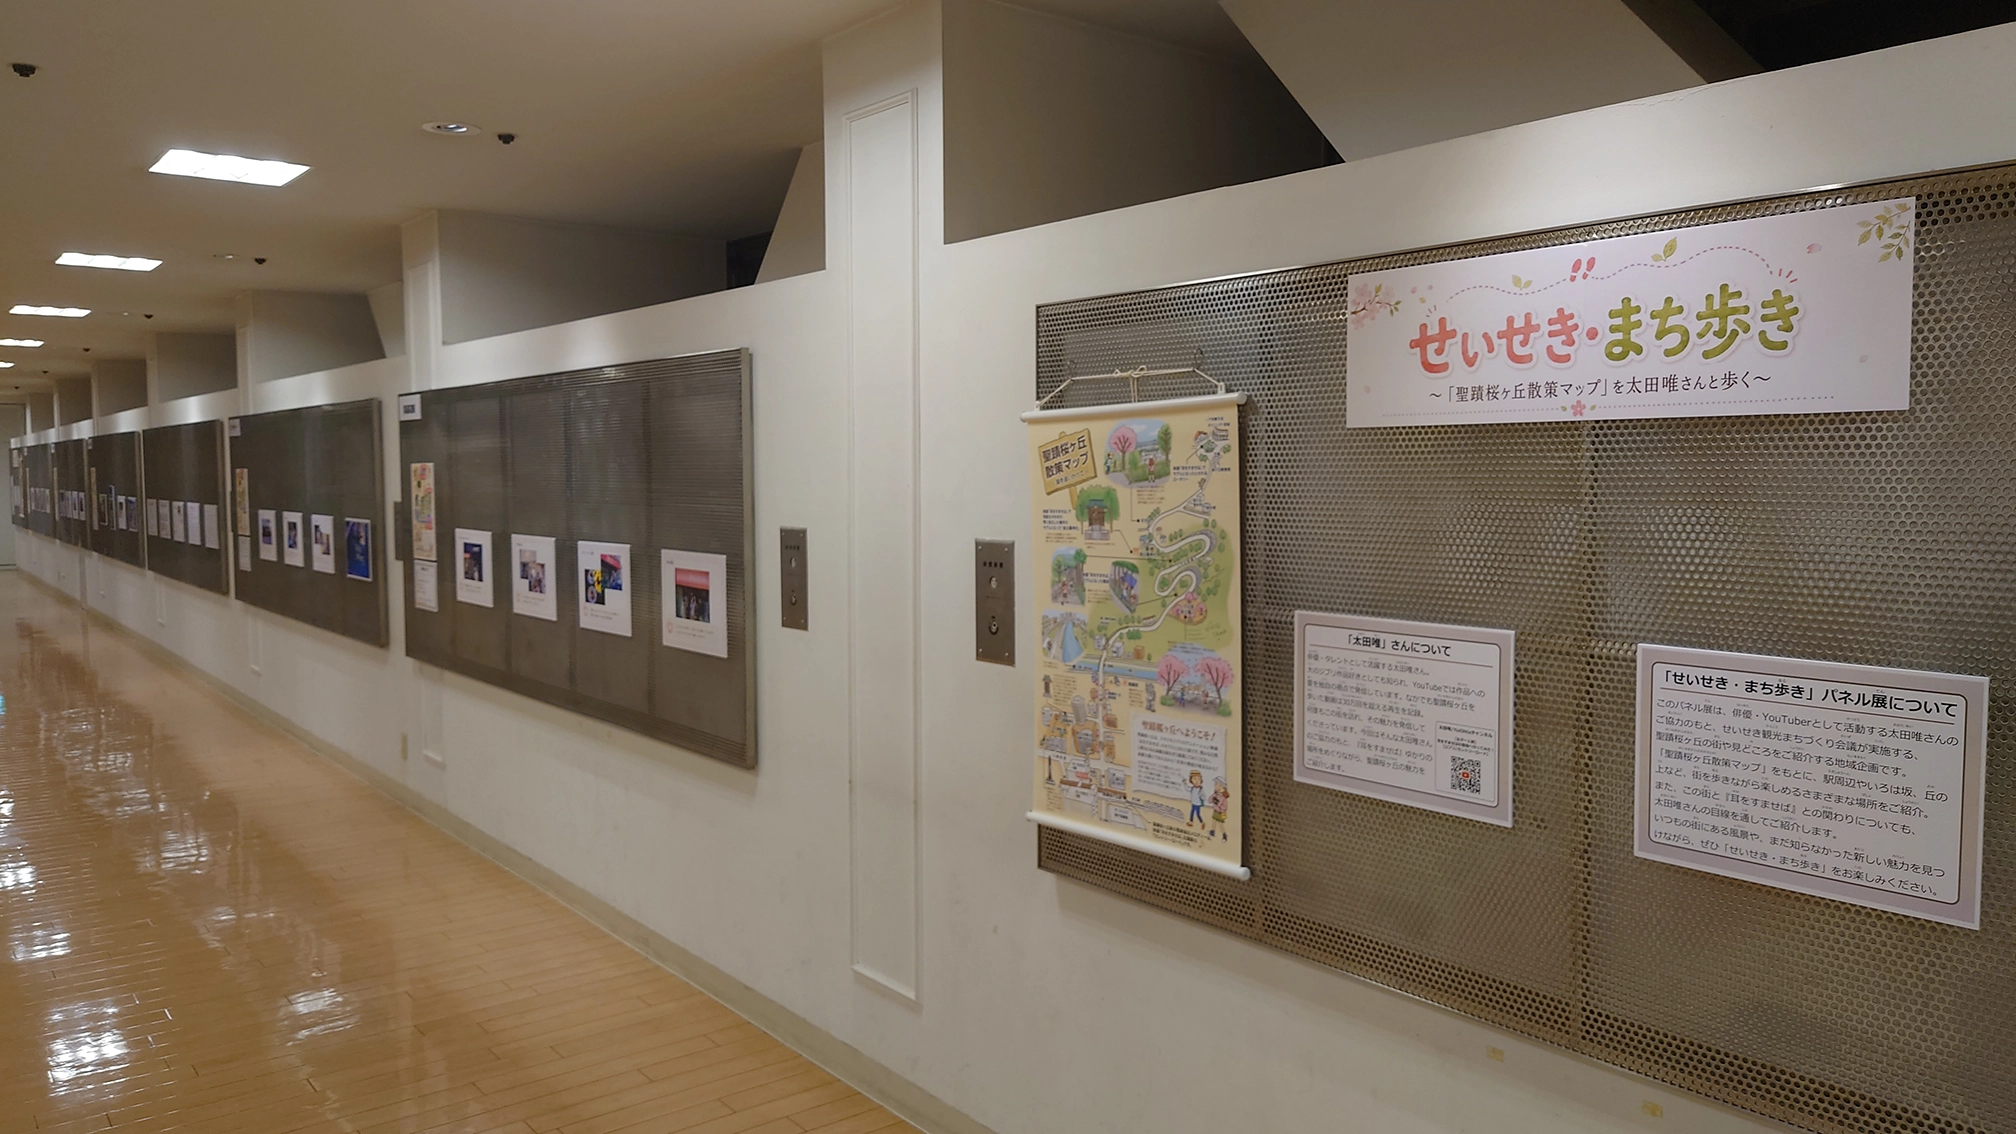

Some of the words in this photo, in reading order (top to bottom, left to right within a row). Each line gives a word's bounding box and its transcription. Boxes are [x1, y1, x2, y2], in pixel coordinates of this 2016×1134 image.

[1409, 283, 1801, 373] せいせき・まち歩き
[1045, 451, 1089, 479] 散策マップ
[1348, 634, 1451, 657] 「太田唯」さんについて
[1665, 669, 1958, 718] 「せいせき・まち歩き」パネル展について
[1655, 715, 1918, 761] ご協力のもと、せいせき観光まちづくり会議が実施する、
[1656, 698, 1959, 747] このパネル展は、俳優・YouTuberとして活動する太田唯さんの
[1655, 731, 1907, 778] 聖蹟桜ヶ丘の街や見どころをご紹介する地域企画です。
[1659, 747, 1949, 803] 「聖蹟桜ヶ丘散策マップ」をもとに、駅周辺やいろは坂、丘の
[1655, 764, 1929, 819] 上など、街を歩きながら楽しめるさまざまな場所をご紹介。
[1655, 780, 1916, 836] また、この街と『耳をすませば』との関わりについても、
[1654, 797, 1838, 840] 太田唯さんの目線を通してご紹介します。
[1654, 814, 1946, 878] いつもの街にある風景や、まだ知らなかった新しい魅力を見つ
[1654, 830, 1938, 896] けながら、ぜひ「せいせき・まち歩き」をお楽しみください。
